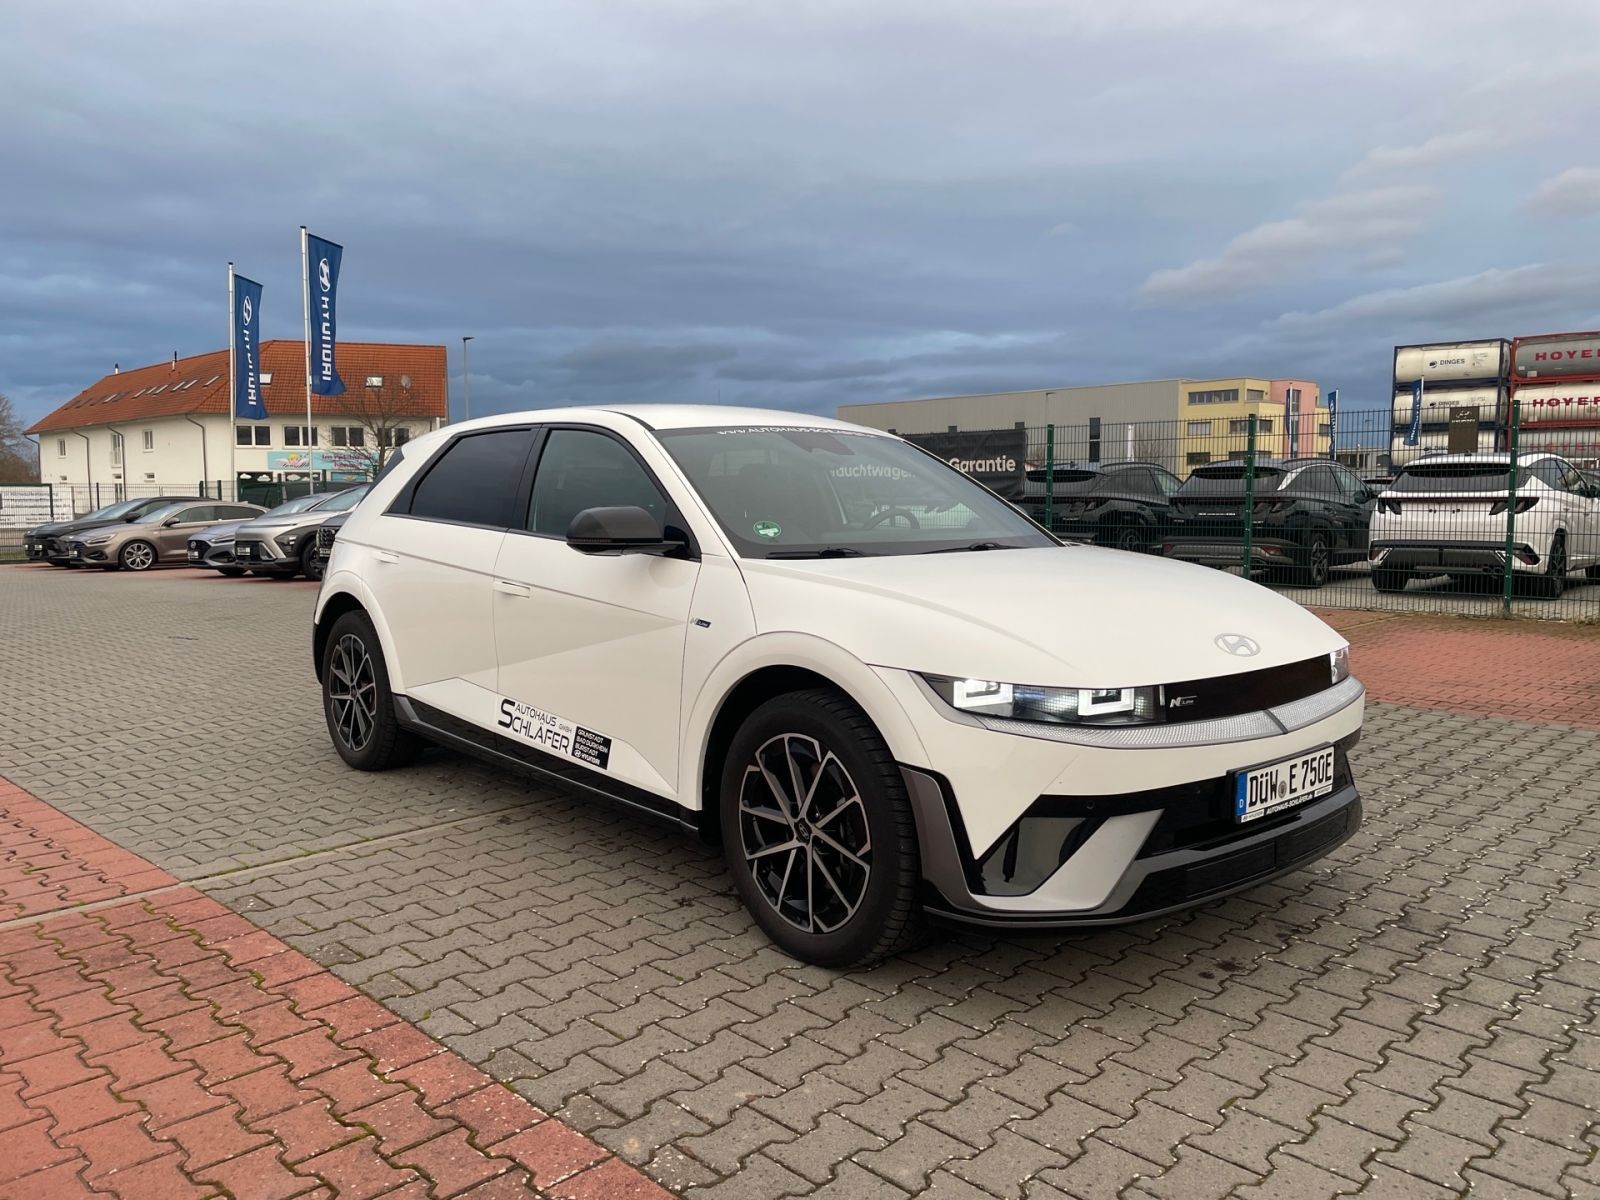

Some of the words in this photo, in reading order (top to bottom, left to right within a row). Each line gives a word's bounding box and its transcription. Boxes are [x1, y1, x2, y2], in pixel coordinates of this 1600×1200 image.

[1439, 358, 1466, 366] DINGES
[1535, 348, 1600, 361] HOYE
[950, 455, 1016, 473] Garantie
[515, 703, 557, 727] AUTOHAUS
[498, 698, 570, 754] SCHLÄFER
[1248, 769, 1279, 808] DÜW
[1289, 763, 1298, 794] E
[1301, 752, 1333, 790] 750E
[1239, 798, 1244, 808] D
